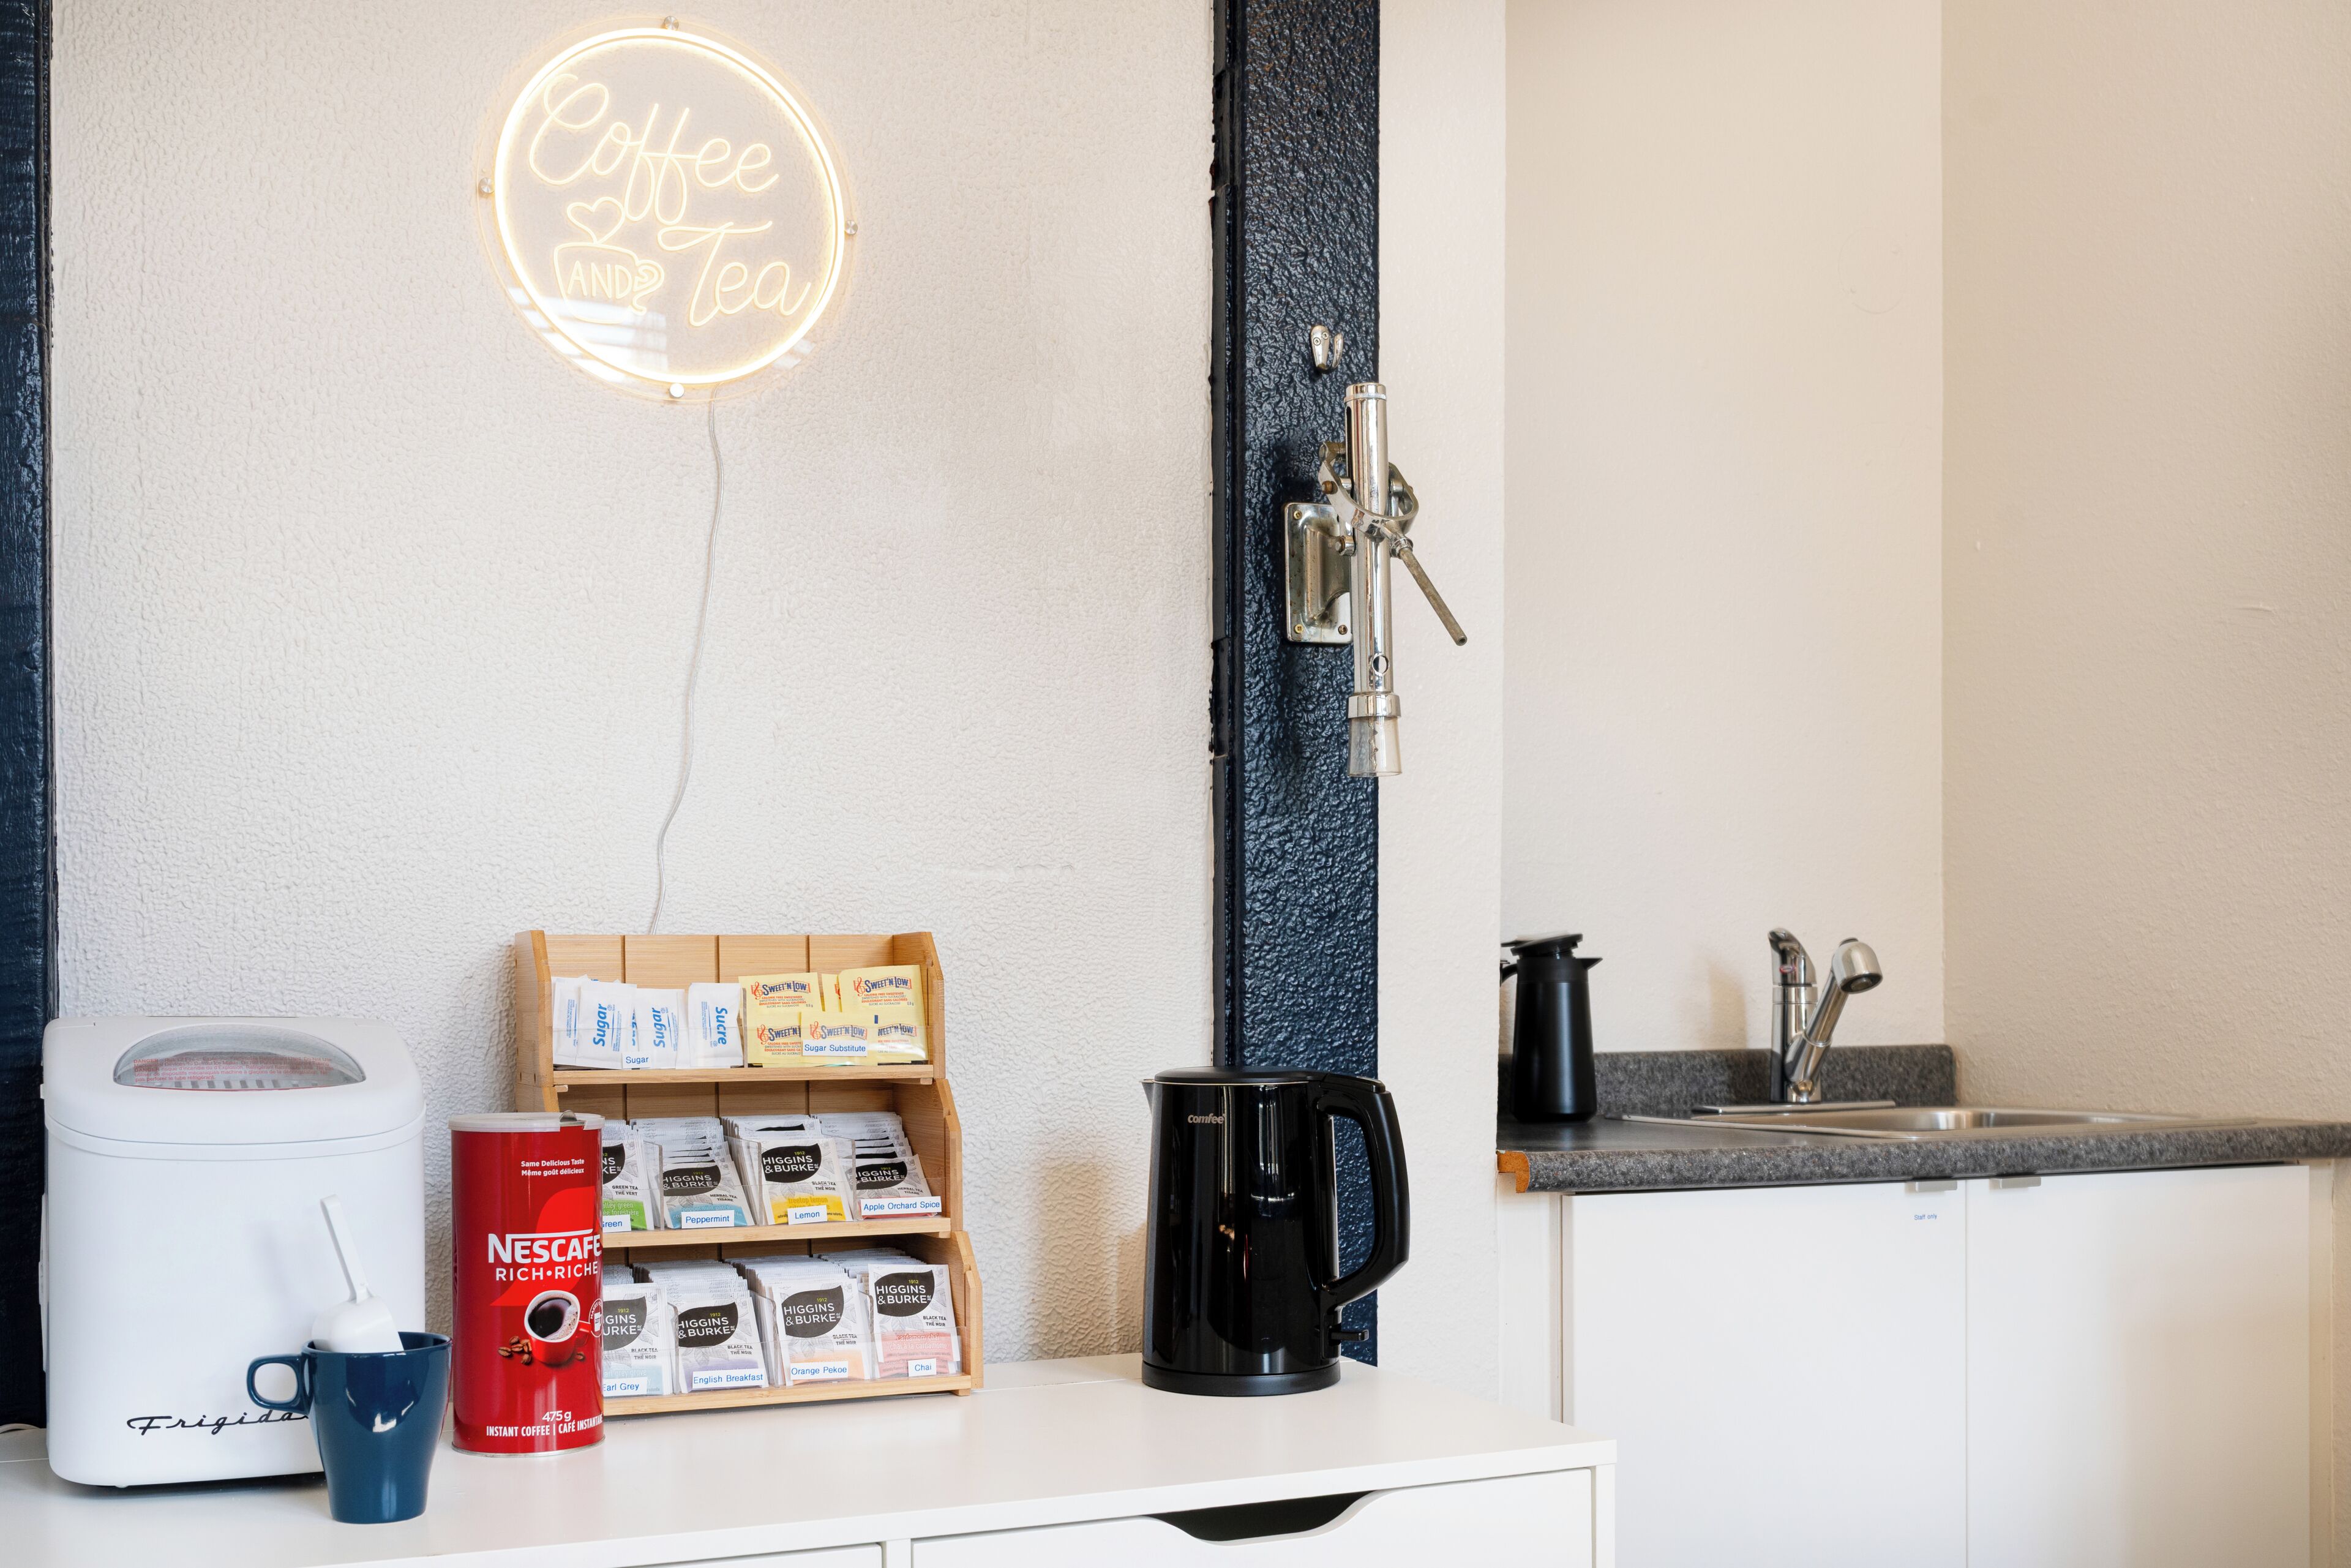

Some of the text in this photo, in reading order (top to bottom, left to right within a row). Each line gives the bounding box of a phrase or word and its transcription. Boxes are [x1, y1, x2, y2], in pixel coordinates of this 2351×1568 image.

[530, 73, 779, 225] Coffee
[567, 260, 632, 299] AND
[657, 221, 812, 327] Tea
[593, 1003, 610, 1046] Sugar
[651, 1007, 667, 1048] Sugar
[716, 1007, 728, 1045] Sucre
[762, 1155, 812, 1165] HIGGINS
[765, 1164, 815, 1174] & BURKE
[686, 1215, 729, 1224] Peppermint
[876, 1285, 926, 1295] HIGGINS
[877, 1294, 927, 1305] & BURKE
[784, 1303, 834, 1315] HIGGINS
[606, 1315, 636, 1325] GINS
[678, 1317, 729, 1329] HIGGINS
[786, 1313, 836, 1326] & BURKE
[603, 1325, 637, 1336] URKE
[678, 1326, 731, 1339] & BURKE
[694, 1373, 763, 1384] English Breakfast
[620, 1382, 639, 1391] Grey
[127, 1409, 309, 1436] Frigida
[542, 1411, 572, 1422] 475 g
[486, 1426, 519, 1437] INSTANT
[521, 1425, 550, 1436] COFFEE
[558, 1420, 575, 1434] CAFÉ
